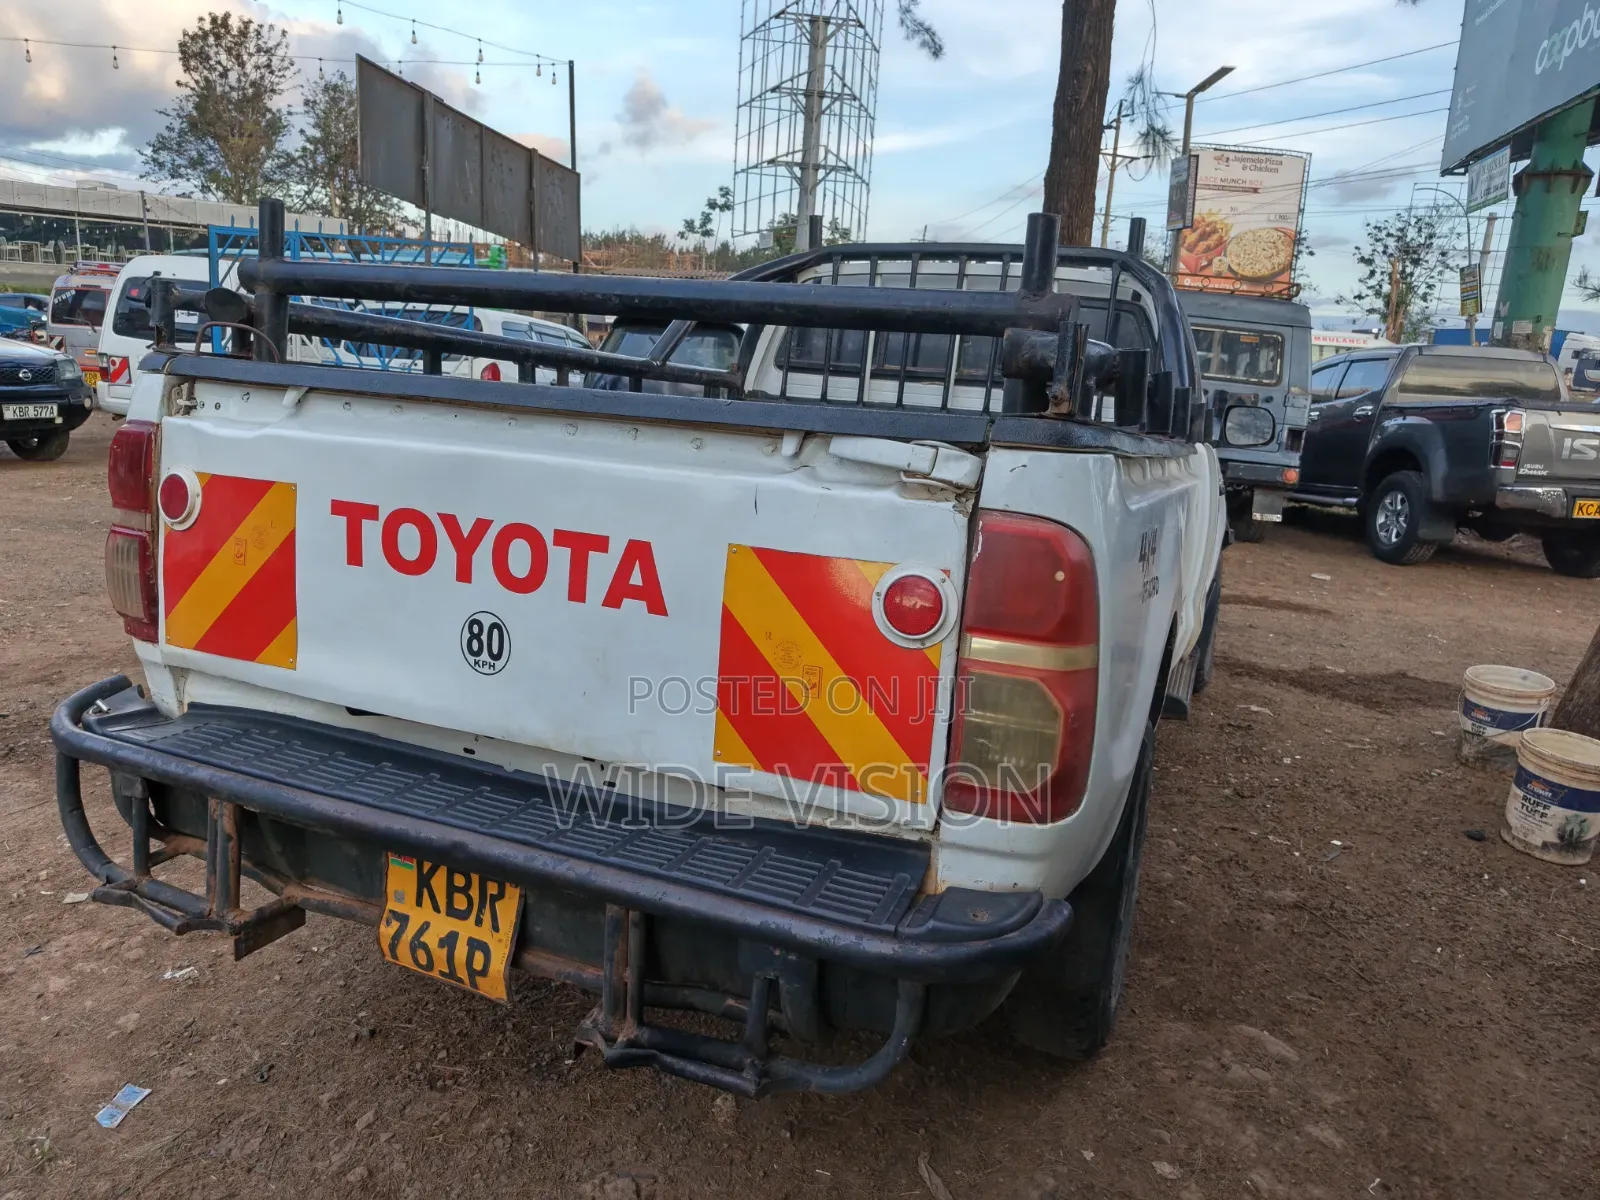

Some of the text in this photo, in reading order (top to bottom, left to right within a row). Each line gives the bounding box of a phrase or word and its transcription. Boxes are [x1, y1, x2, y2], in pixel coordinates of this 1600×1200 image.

[1249, 164, 1279, 174] Chicken
[1264, 156, 1283, 166] Pizza
[1197, 176, 1263, 187] ARGE MUNCH BOX
[1313, 336, 1368, 345] MBULANCE
[12, 405, 54, 417] KBR 577A
[1561, 437, 1600, 460] IS
[331, 498, 669, 617] TOYOTA
[466, 617, 505, 662] 80
[473, 658, 496, 671] KPH
[1520, 802, 1549, 819] TUFF
[1521, 794, 1551, 811] RUFF
[415, 857, 506, 934] KBR
[385, 908, 492, 991] 761P
